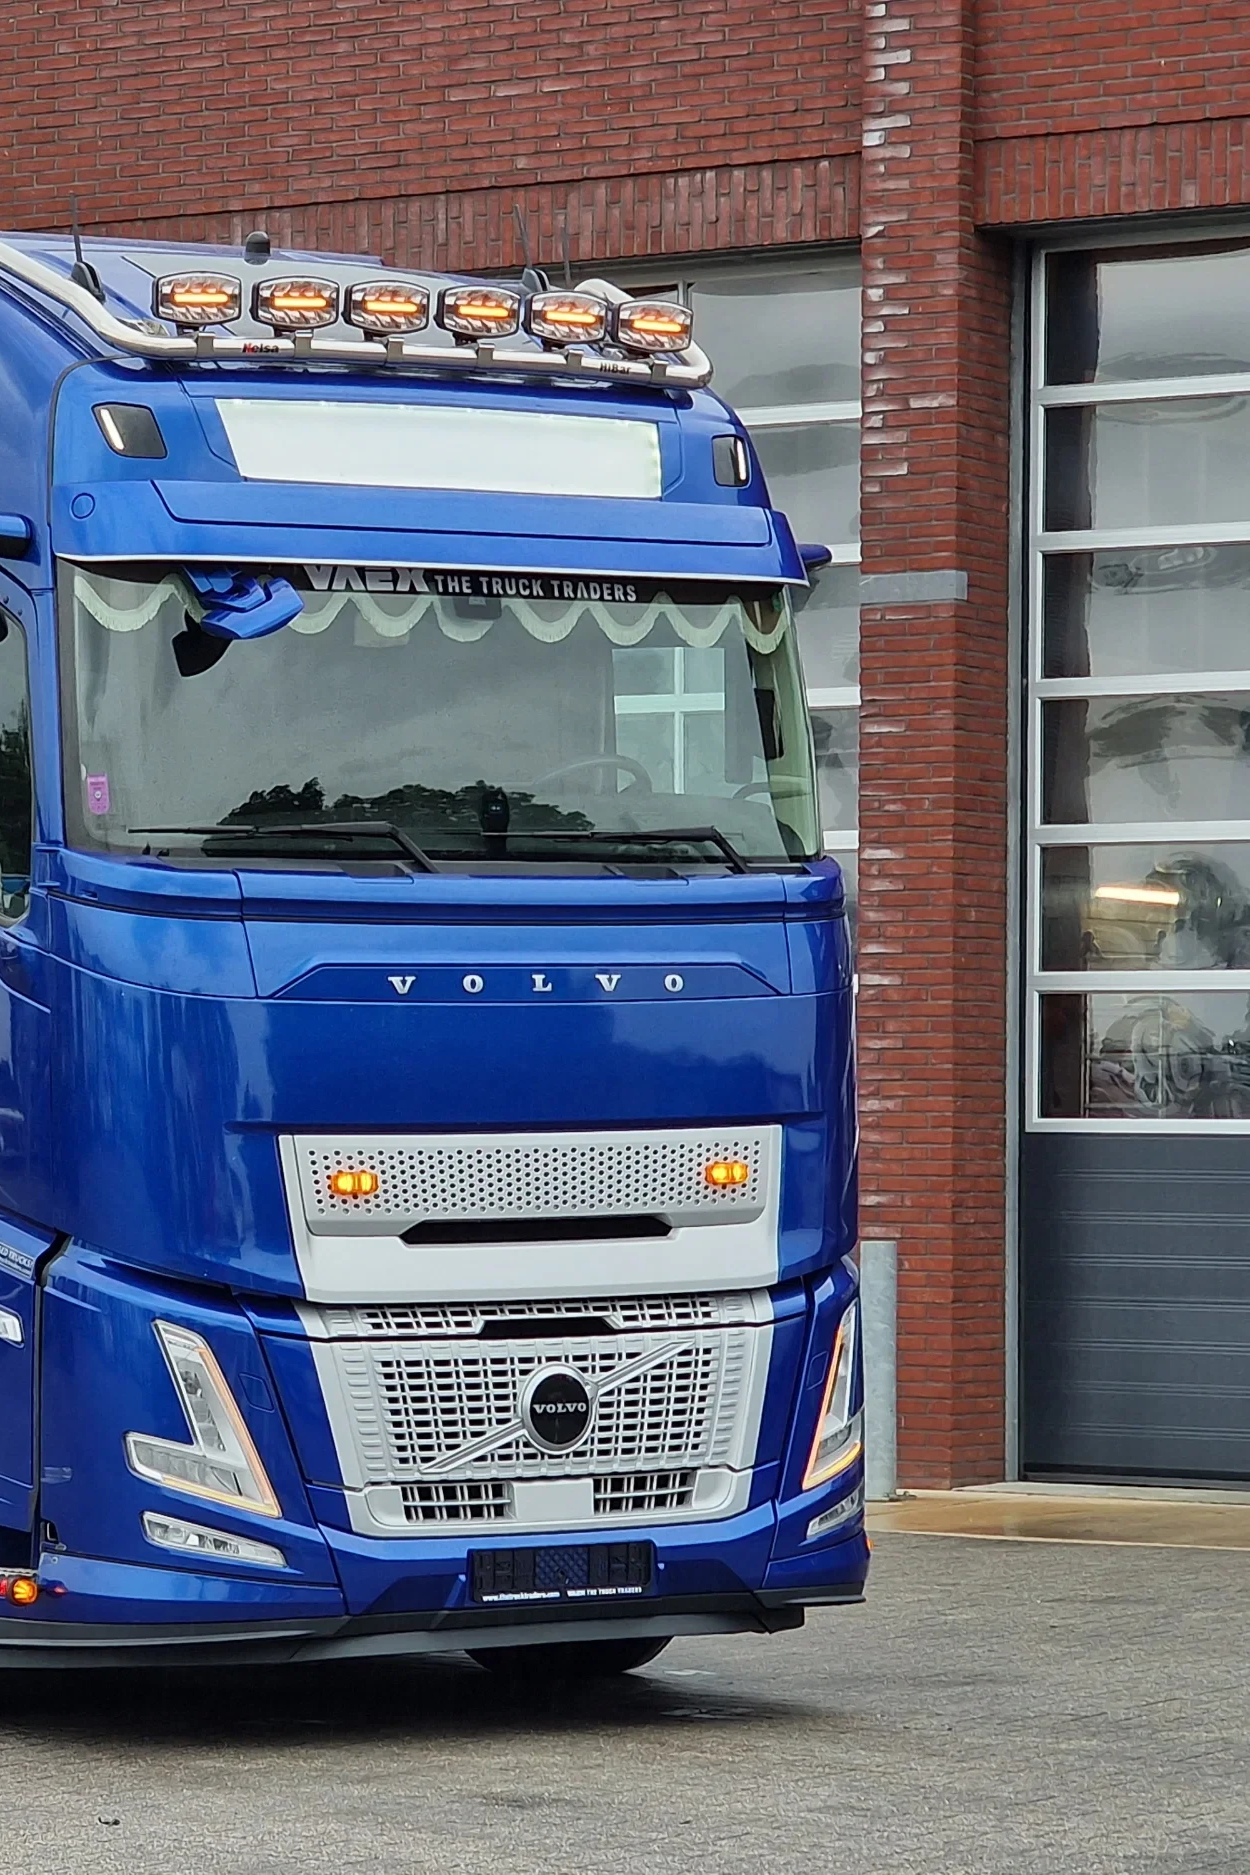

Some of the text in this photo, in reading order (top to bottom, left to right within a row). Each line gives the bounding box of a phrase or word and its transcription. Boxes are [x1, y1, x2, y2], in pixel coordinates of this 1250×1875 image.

[434, 575, 472, 594] THE
[479, 577, 545, 597] TRUCK
[550, 580, 637, 602] TRADERS
[388, 974, 685, 995] VOLVO
[533, 1402, 587, 1414] VOLVO
